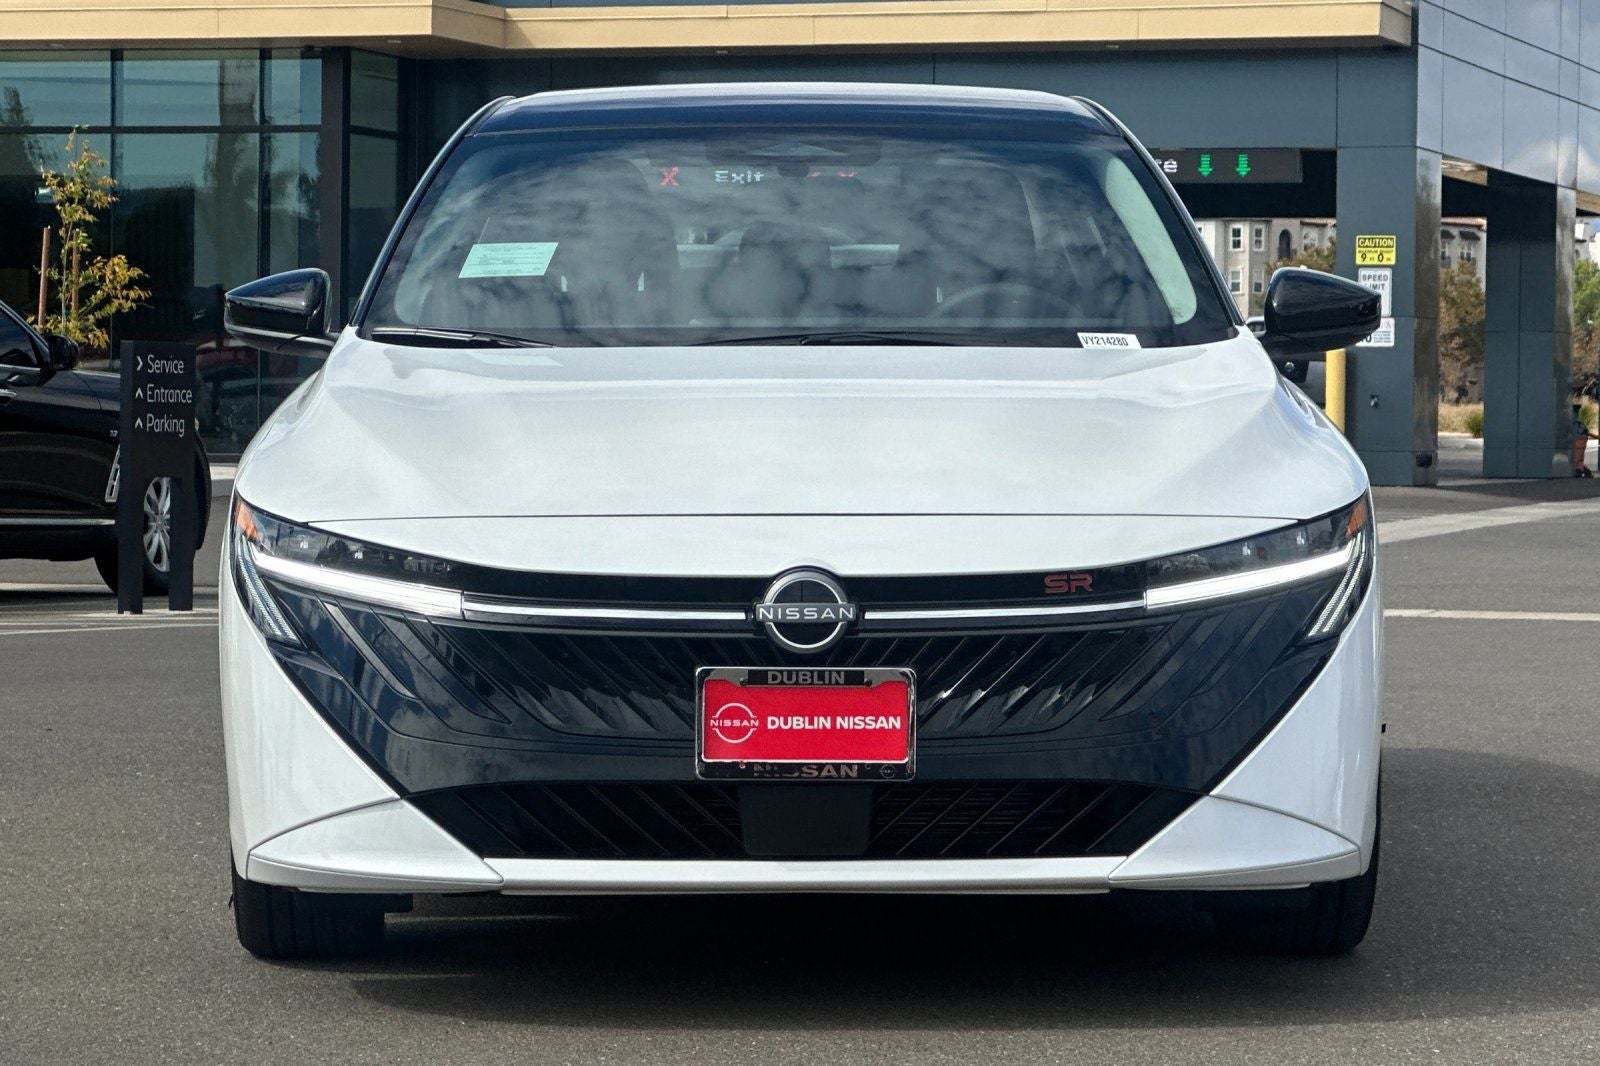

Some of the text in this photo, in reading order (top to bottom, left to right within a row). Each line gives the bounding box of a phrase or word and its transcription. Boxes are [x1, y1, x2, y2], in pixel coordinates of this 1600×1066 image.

[715, 170, 764, 183] Exit
[1359, 238, 1393, 247] CAUTION
[1361, 253, 1367, 262] 9
[1378, 253, 1384, 262] 0
[147, 354, 184, 374] Service
[146, 384, 192, 403] Entrance
[146, 413, 185, 437] Parking
[1044, 573, 1093, 593] SR
[759, 607, 854, 620] NISSAN
[767, 670, 845, 685] DUBLIN
[710, 719, 759, 727] NISSAN
[767, 716, 900, 730] DUBLIN NISSAN
